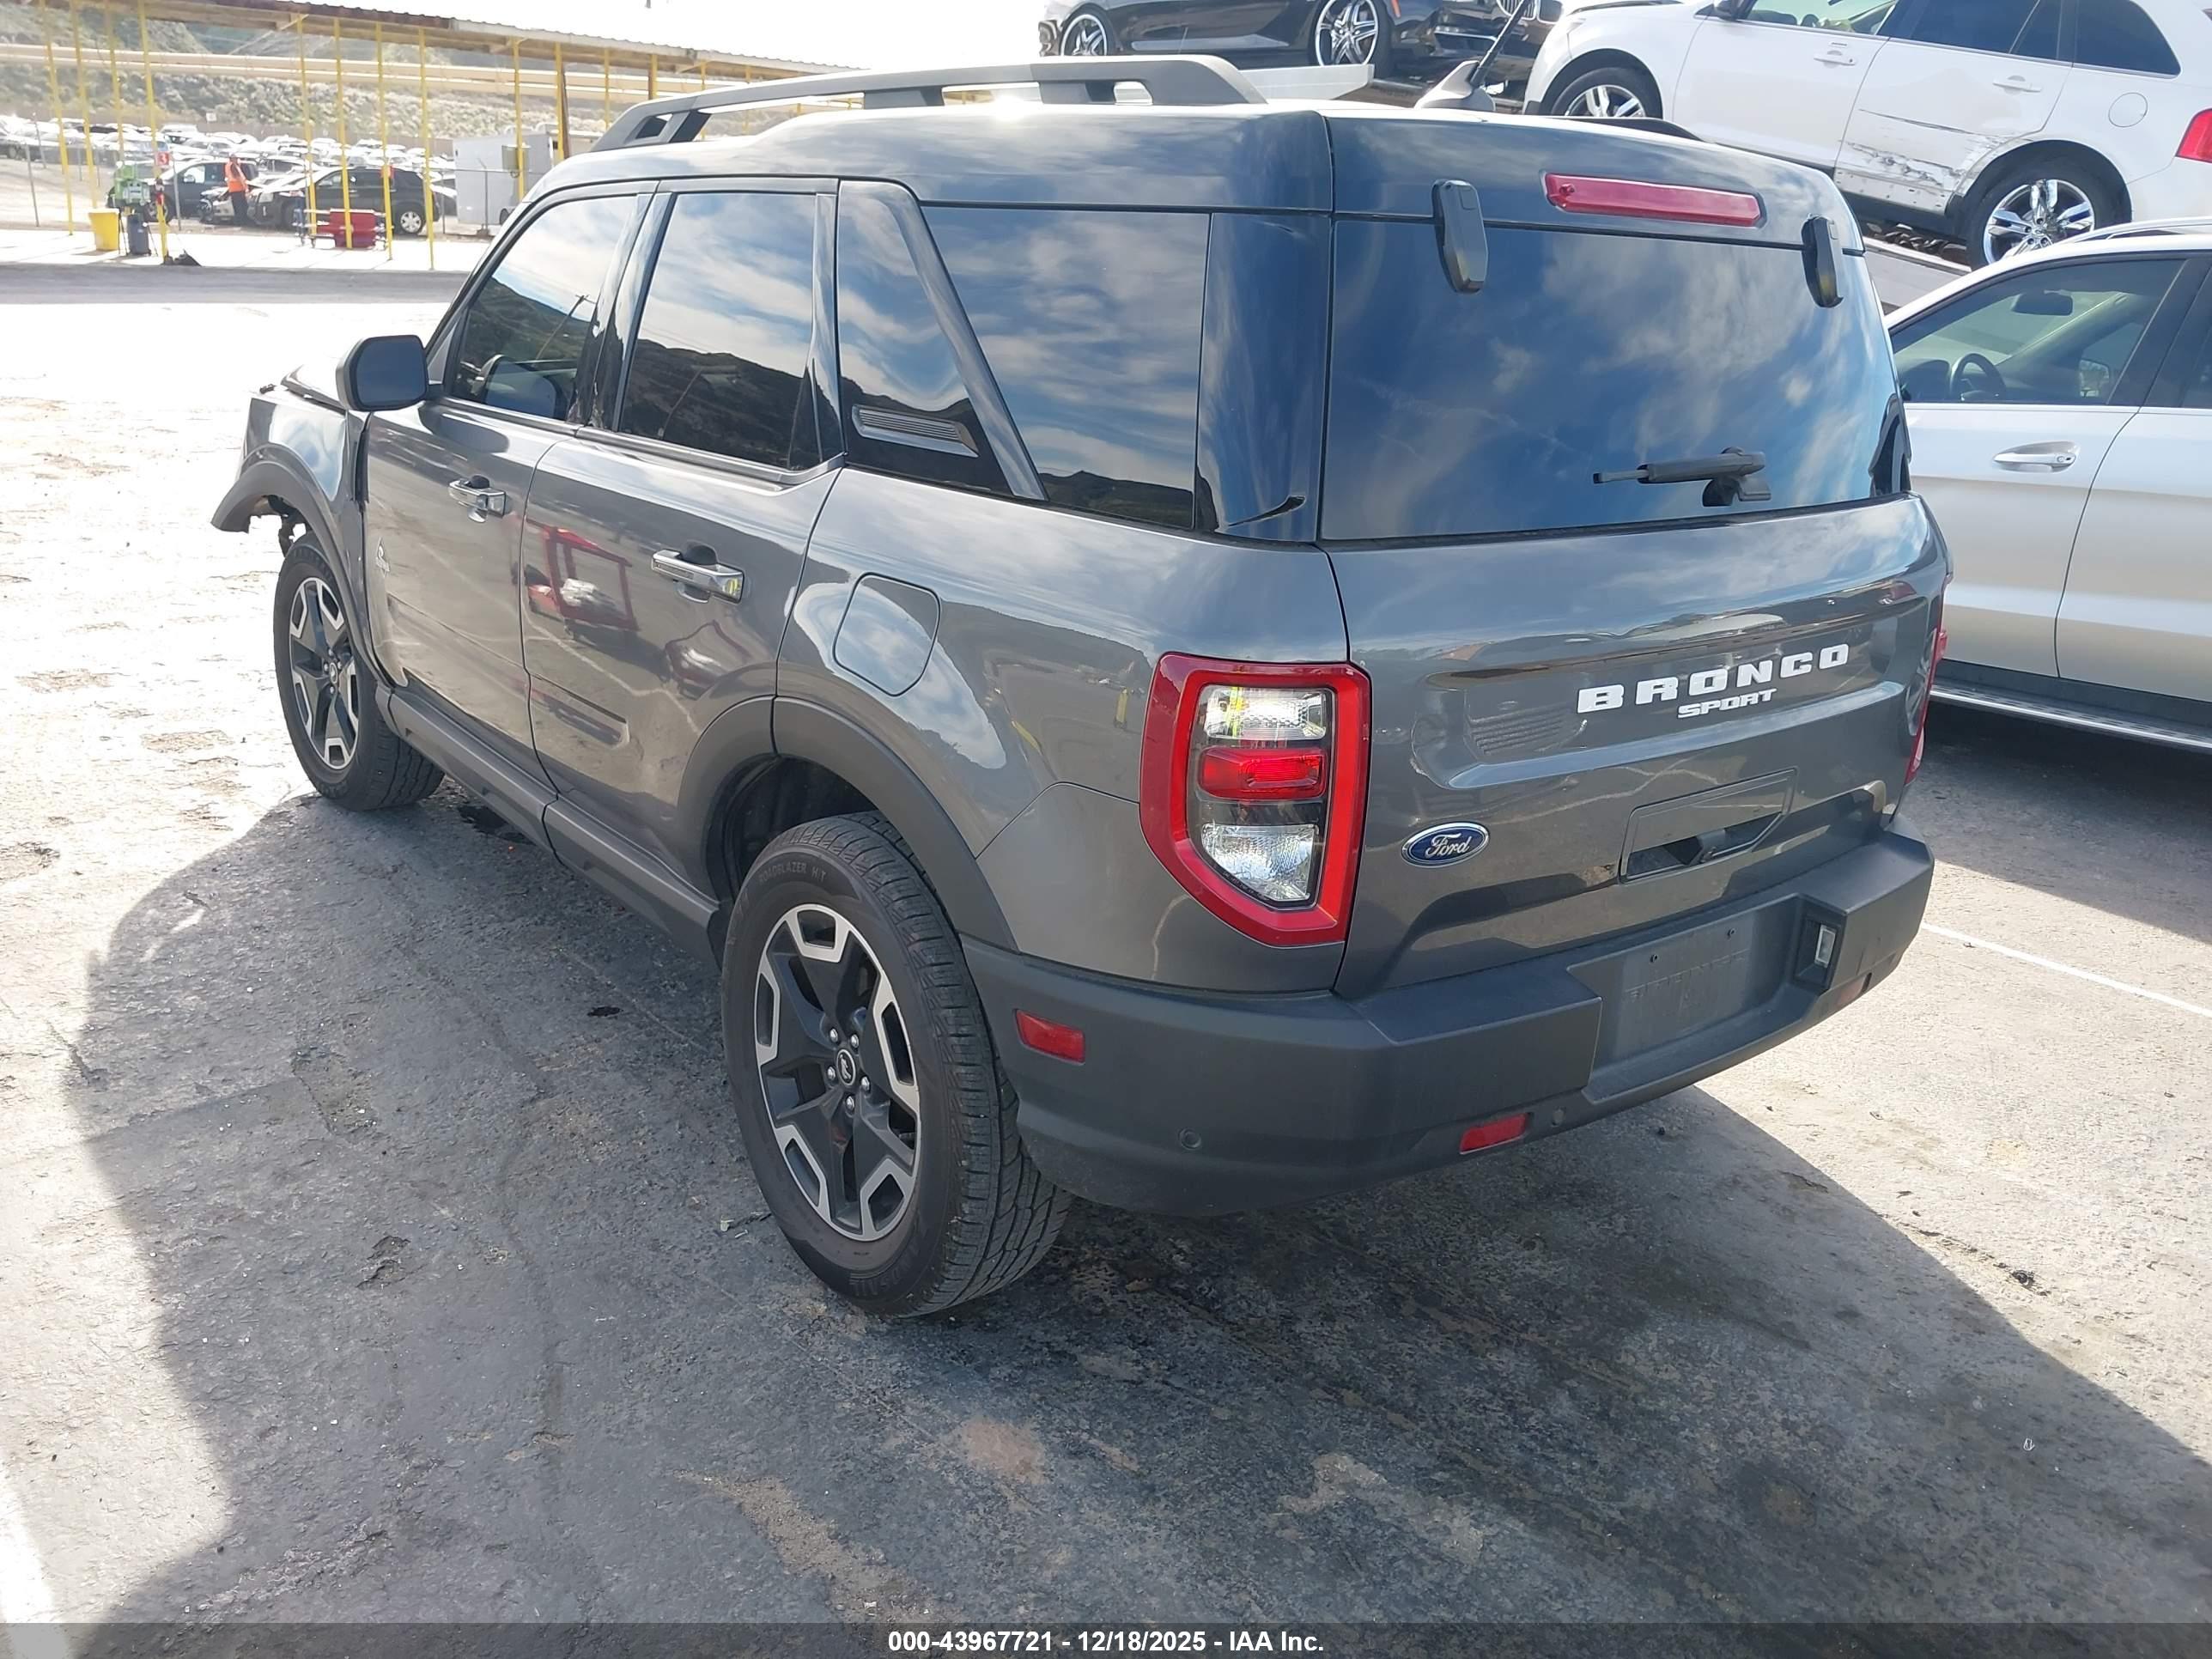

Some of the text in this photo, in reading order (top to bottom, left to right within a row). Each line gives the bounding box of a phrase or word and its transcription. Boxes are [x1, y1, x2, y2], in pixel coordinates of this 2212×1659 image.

[158, 152, 167, 164] 3
[1577, 644, 1849, 714] BRONCO
[1678, 689, 1777, 718] SPORT
[1425, 832, 1473, 858] Ford
